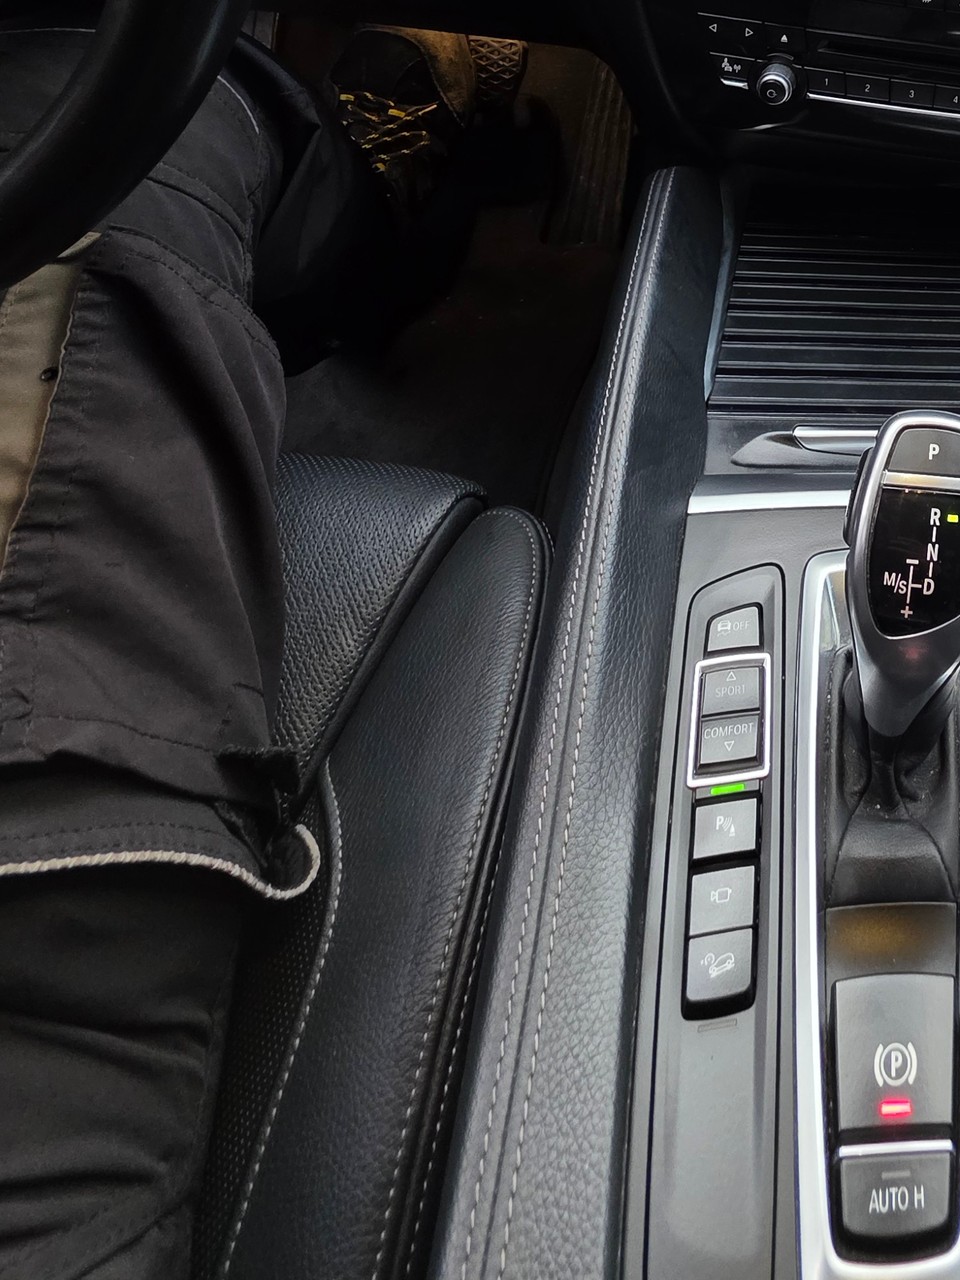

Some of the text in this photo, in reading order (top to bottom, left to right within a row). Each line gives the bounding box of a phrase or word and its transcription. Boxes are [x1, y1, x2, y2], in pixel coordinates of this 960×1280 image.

[864, 84, 871, 93] 2
[909, 89, 915, 98] 3
[952, 95, 958, 104] 4
[928, 442, 940, 460] P
[929, 508, 941, 526] R
[926, 543, 939, 561] N
[883, 571, 908, 595] M/S
[923, 577, 935, 595] D
[732, 620, 750, 632] OFF
[714, 683, 746, 698] SPORT
[703, 722, 754, 740] COMFORT
[869, 1185, 925, 1213] AUTO H
